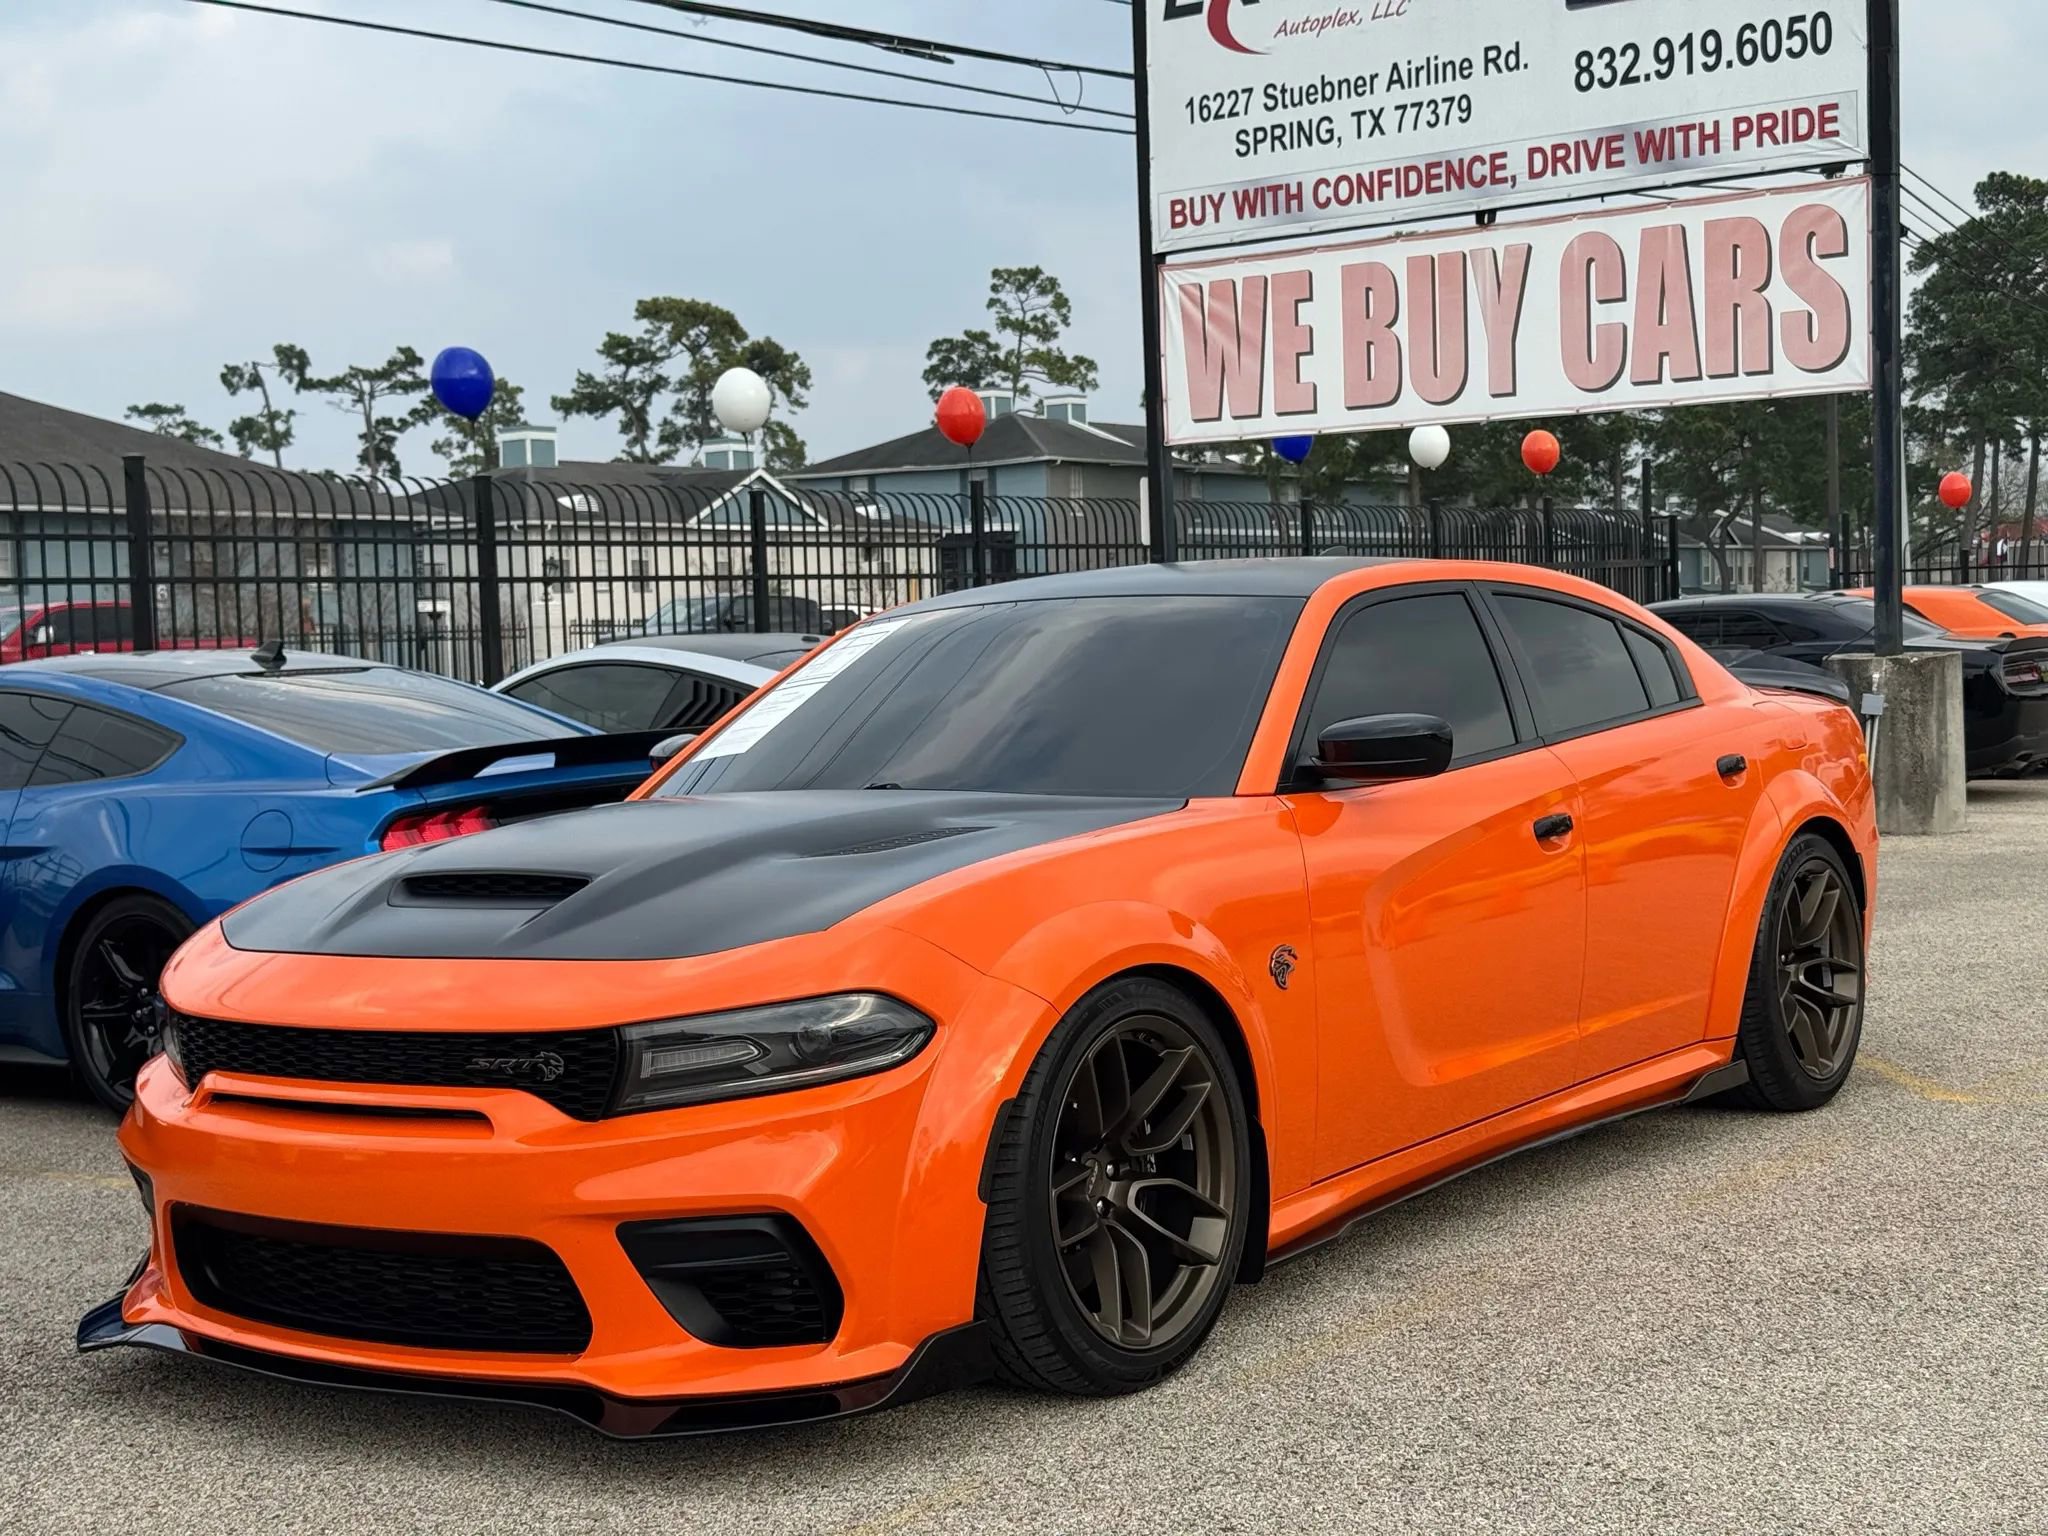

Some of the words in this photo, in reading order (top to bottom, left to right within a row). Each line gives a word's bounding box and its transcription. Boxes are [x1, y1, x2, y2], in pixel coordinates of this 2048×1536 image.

[1274, 7, 1363, 38] Autoplex,
[1371, 0, 1411, 20] LLC
[1574, 11, 1832, 93] 832.919.6050
[1185, 88, 1254, 125] 16227
[1263, 72, 1379, 113] Stuebner
[1385, 55, 1473, 93] Airline
[1483, 41, 1528, 77] Rd.
[1170, 191, 1226, 229] BUY
[1233, 181, 1303, 220] WITH
[1312, 152, 1517, 210] CONFIDENCE,
[1527, 134, 1626, 181] DRIVE
[1634, 120, 1721, 164] WITH
[1733, 103, 1840, 151] PRIDE
[1235, 116, 1343, 158] SPRING,
[1351, 107, 1386, 140] TX
[1394, 94, 1472, 132] 77379
[1178, 269, 1317, 424] WE
[1340, 243, 1531, 411] BUY
[1559, 203, 1851, 392] CARS
[465, 1058, 544, 1075] SRT
